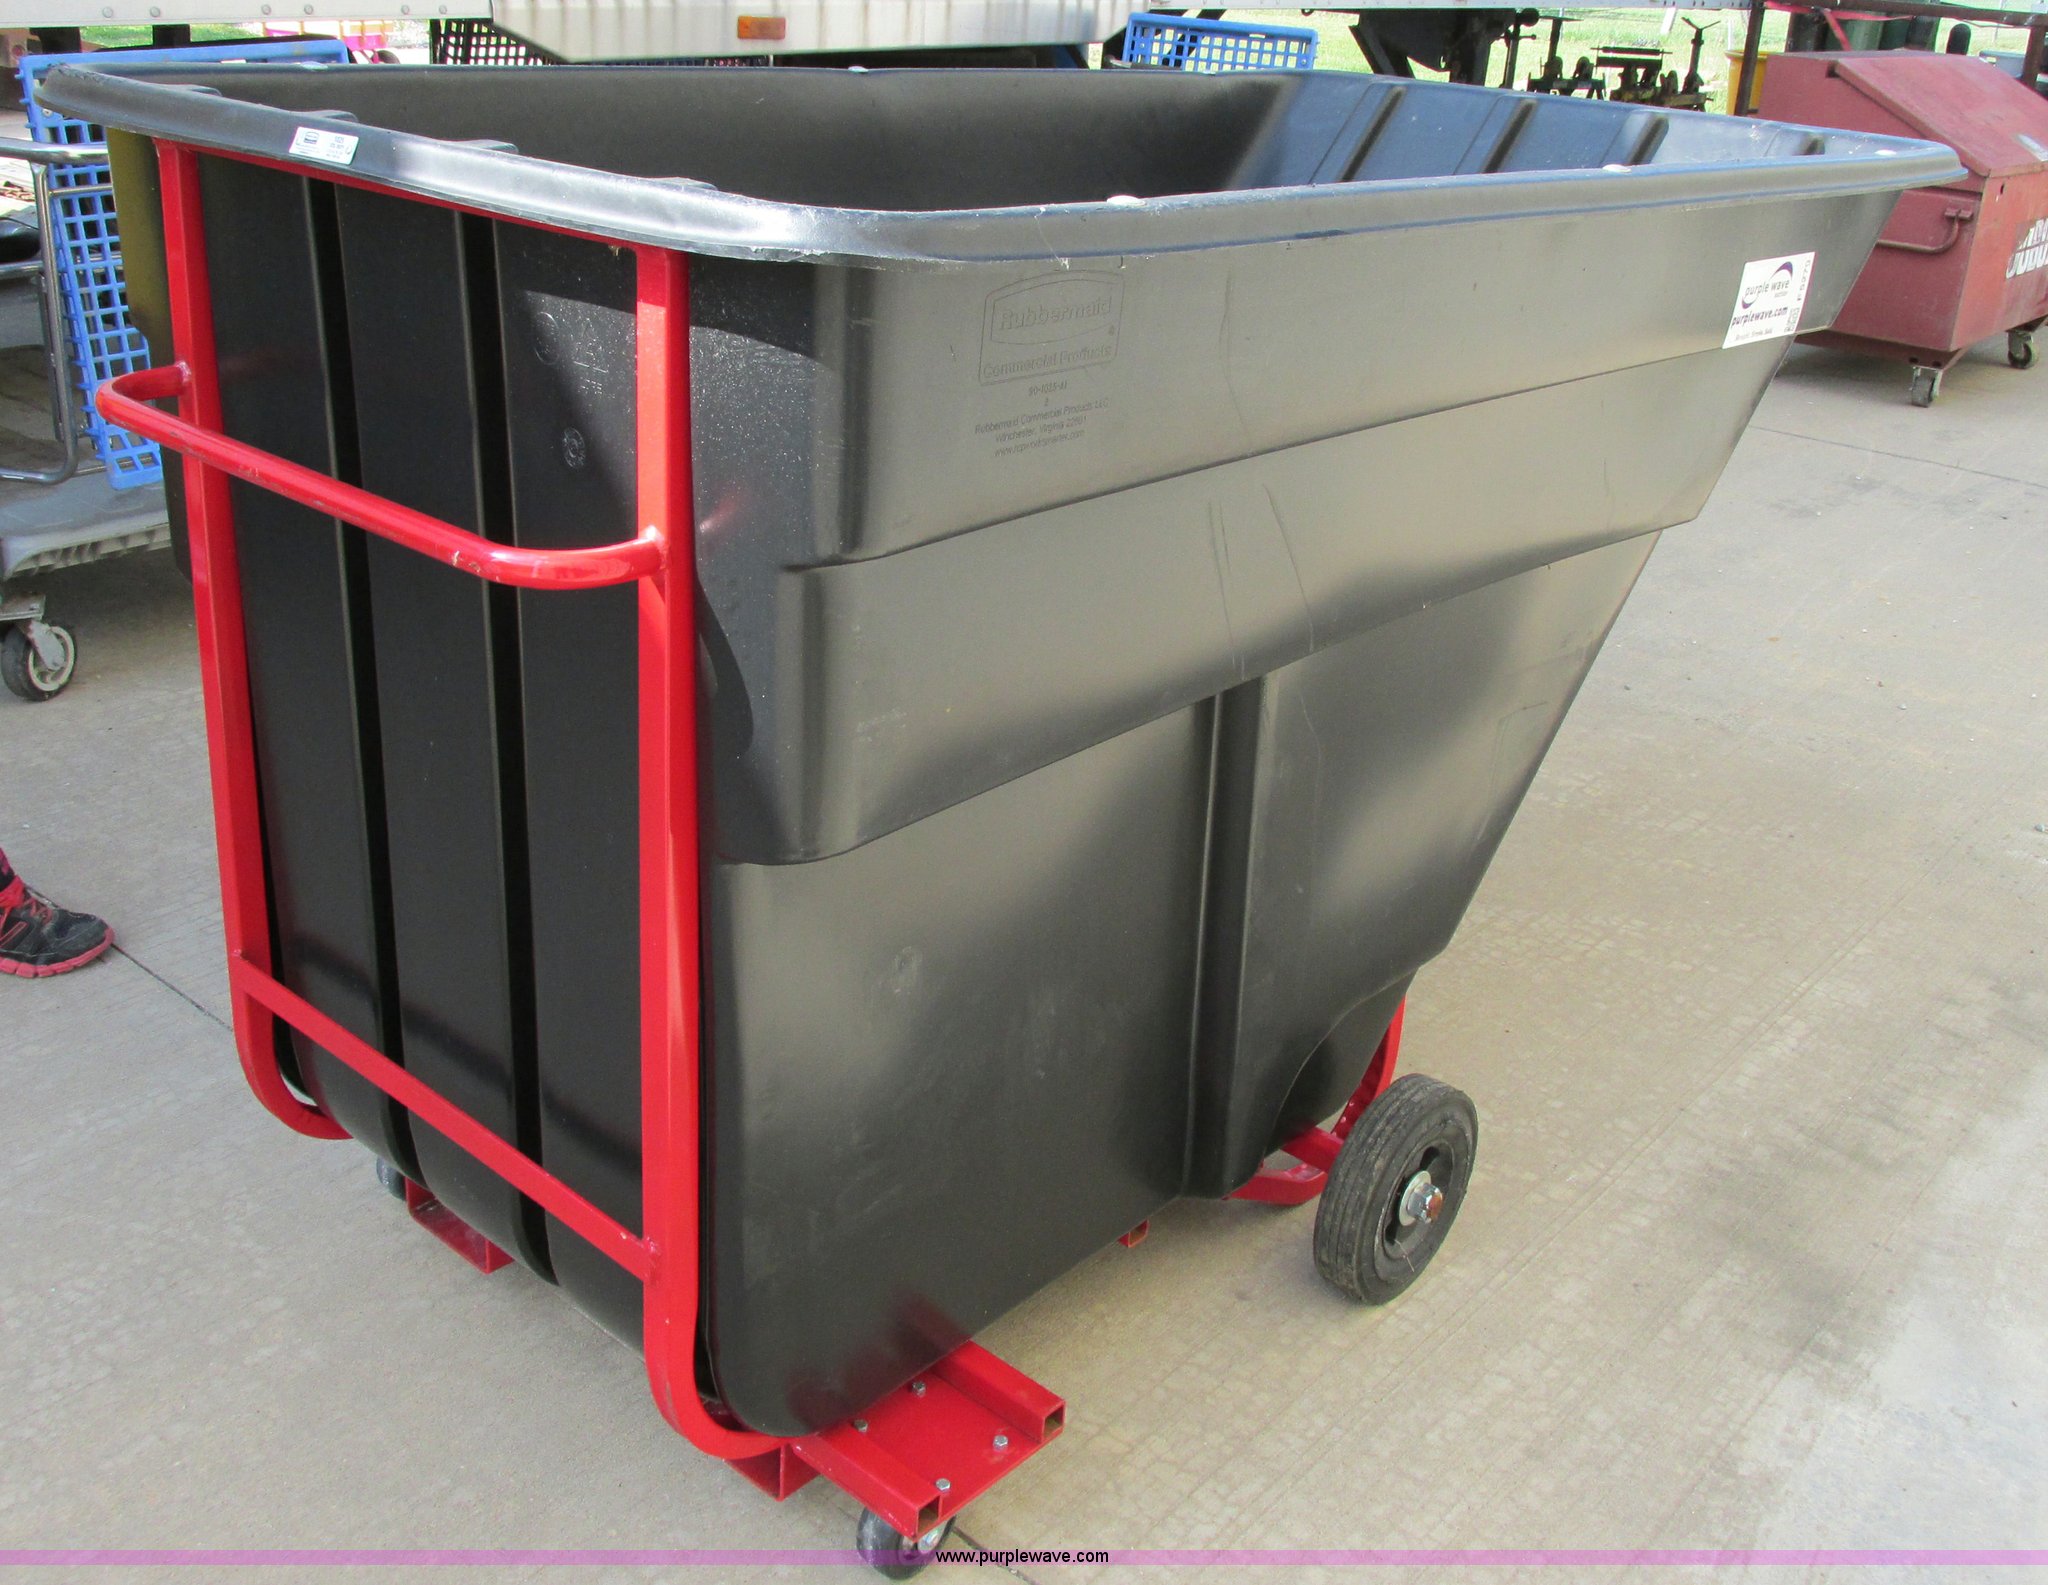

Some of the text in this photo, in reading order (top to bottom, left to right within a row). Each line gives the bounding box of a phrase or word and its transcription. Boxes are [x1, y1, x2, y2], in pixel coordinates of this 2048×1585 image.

[1745, 281, 1769, 296] purple
[1771, 279, 1790, 290] wave
[999, 295, 1112, 331] Rubbermaid
[1731, 306, 1788, 328] purplewave.com
[983, 344, 1112, 379] Commercial Products
[975, 416, 1019, 434] Rubbermaid
[1021, 408, 1062, 425] Commercial
